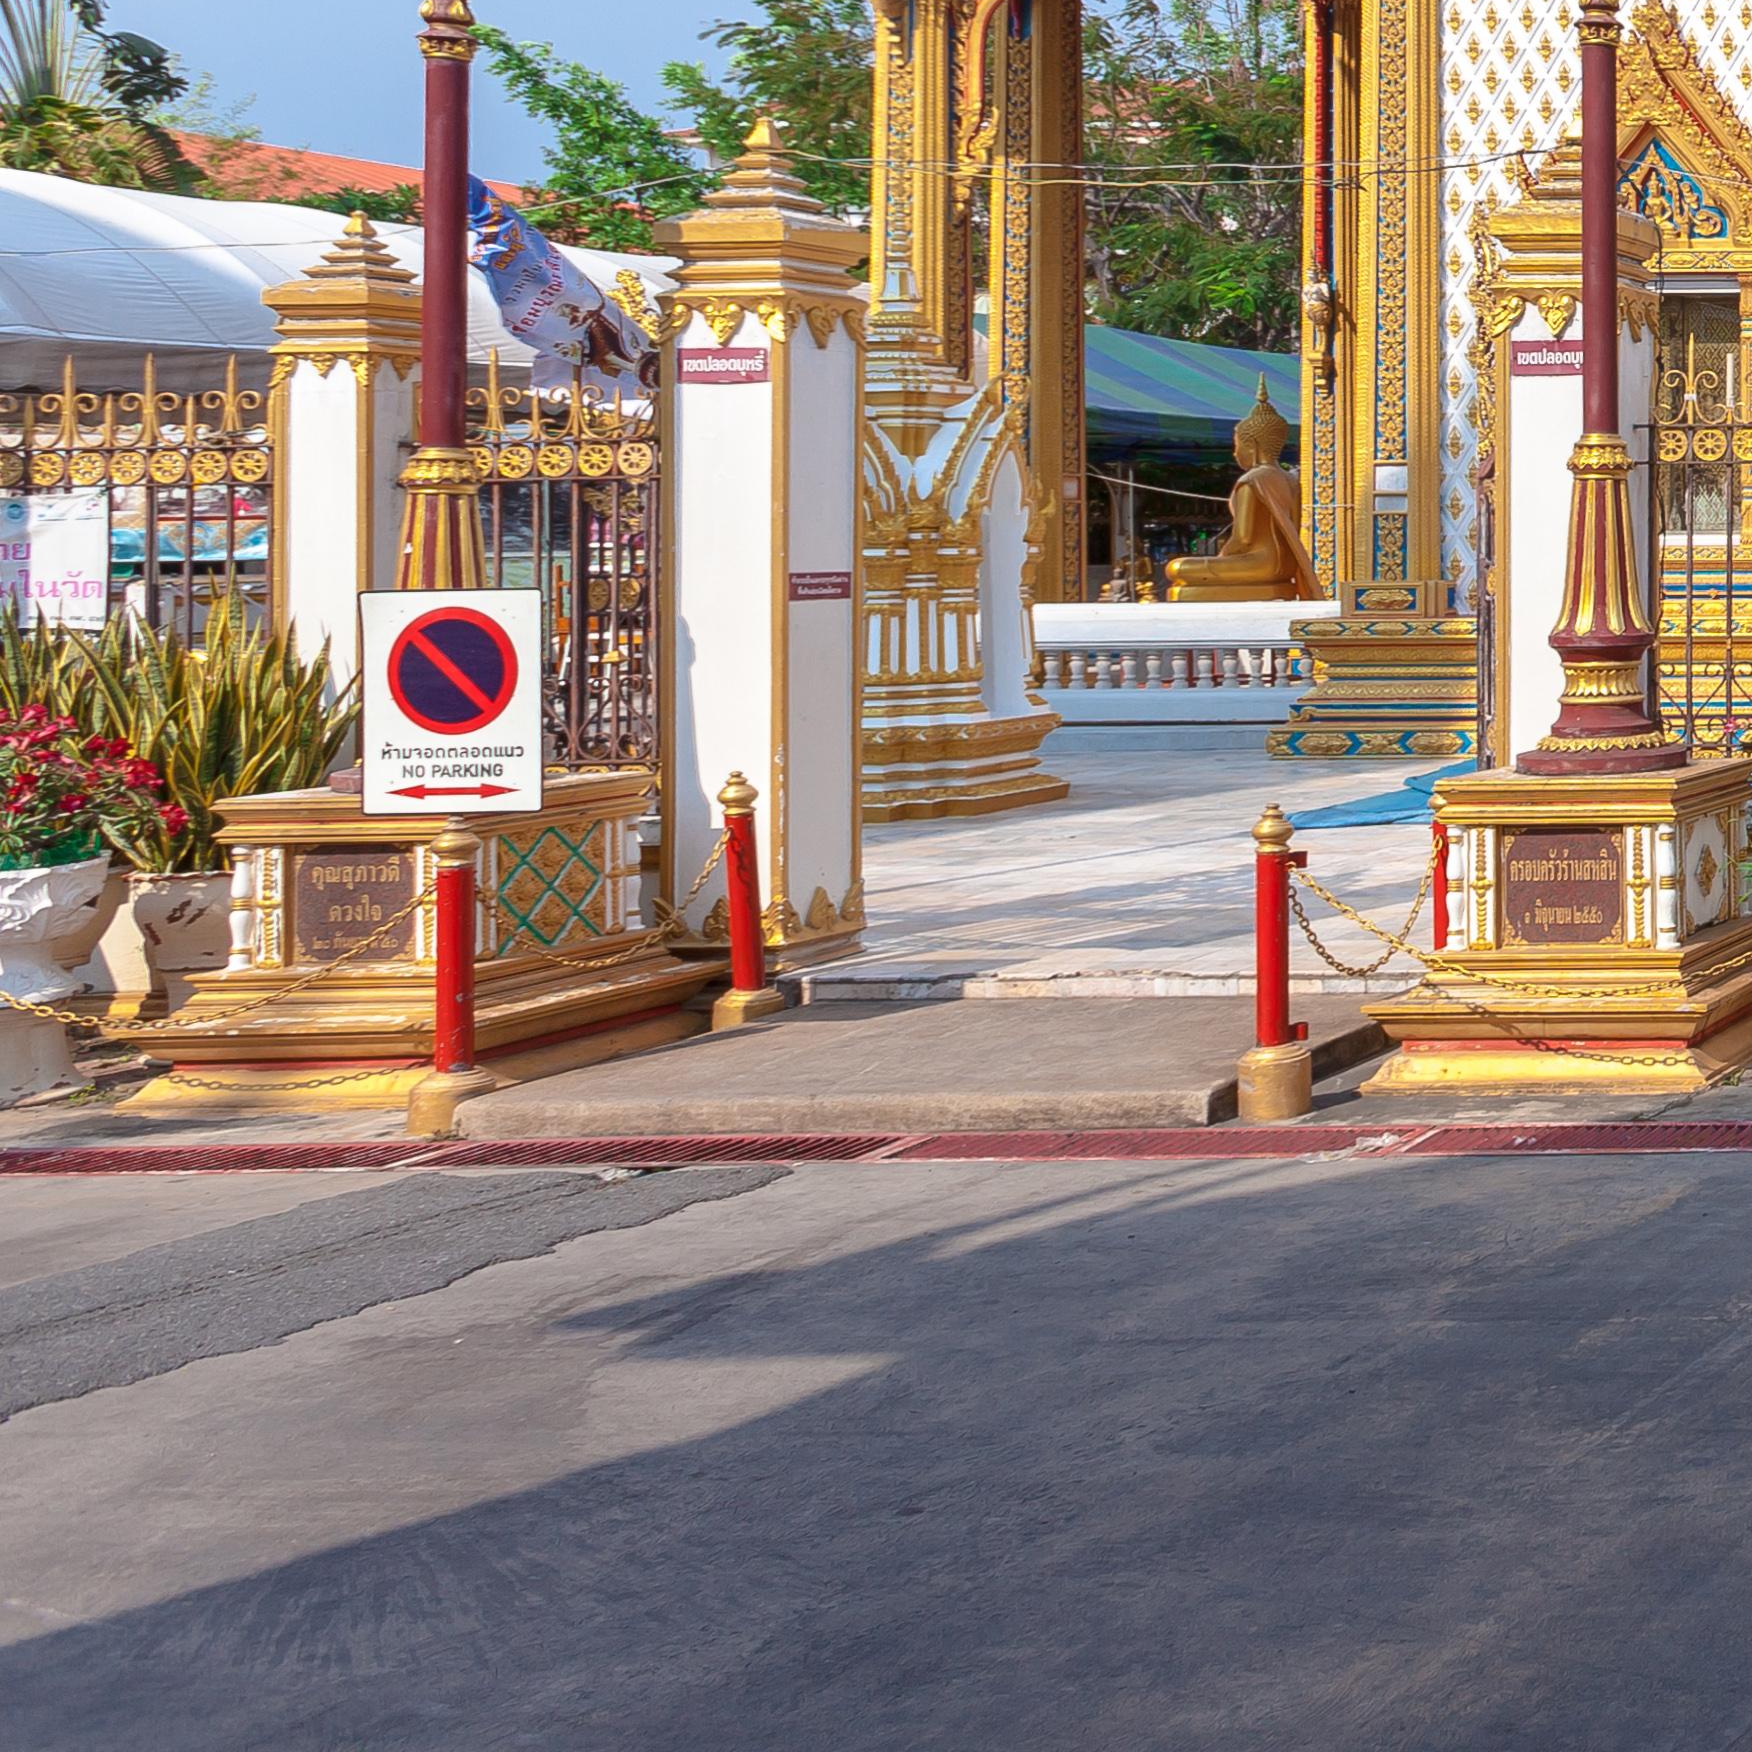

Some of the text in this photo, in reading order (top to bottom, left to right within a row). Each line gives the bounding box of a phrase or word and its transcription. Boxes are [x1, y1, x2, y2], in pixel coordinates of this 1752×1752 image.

[683, 350, 765, 376] เขตปลอดบุหรี่
[1517, 348, 1583, 369] เขตปลอดบุ
[381, 742, 525, 760] ห้ามจอดตลอดแนว
[402, 763, 504, 779] NO PARKING
[312, 855, 400, 890] คุณสุภาวดี
